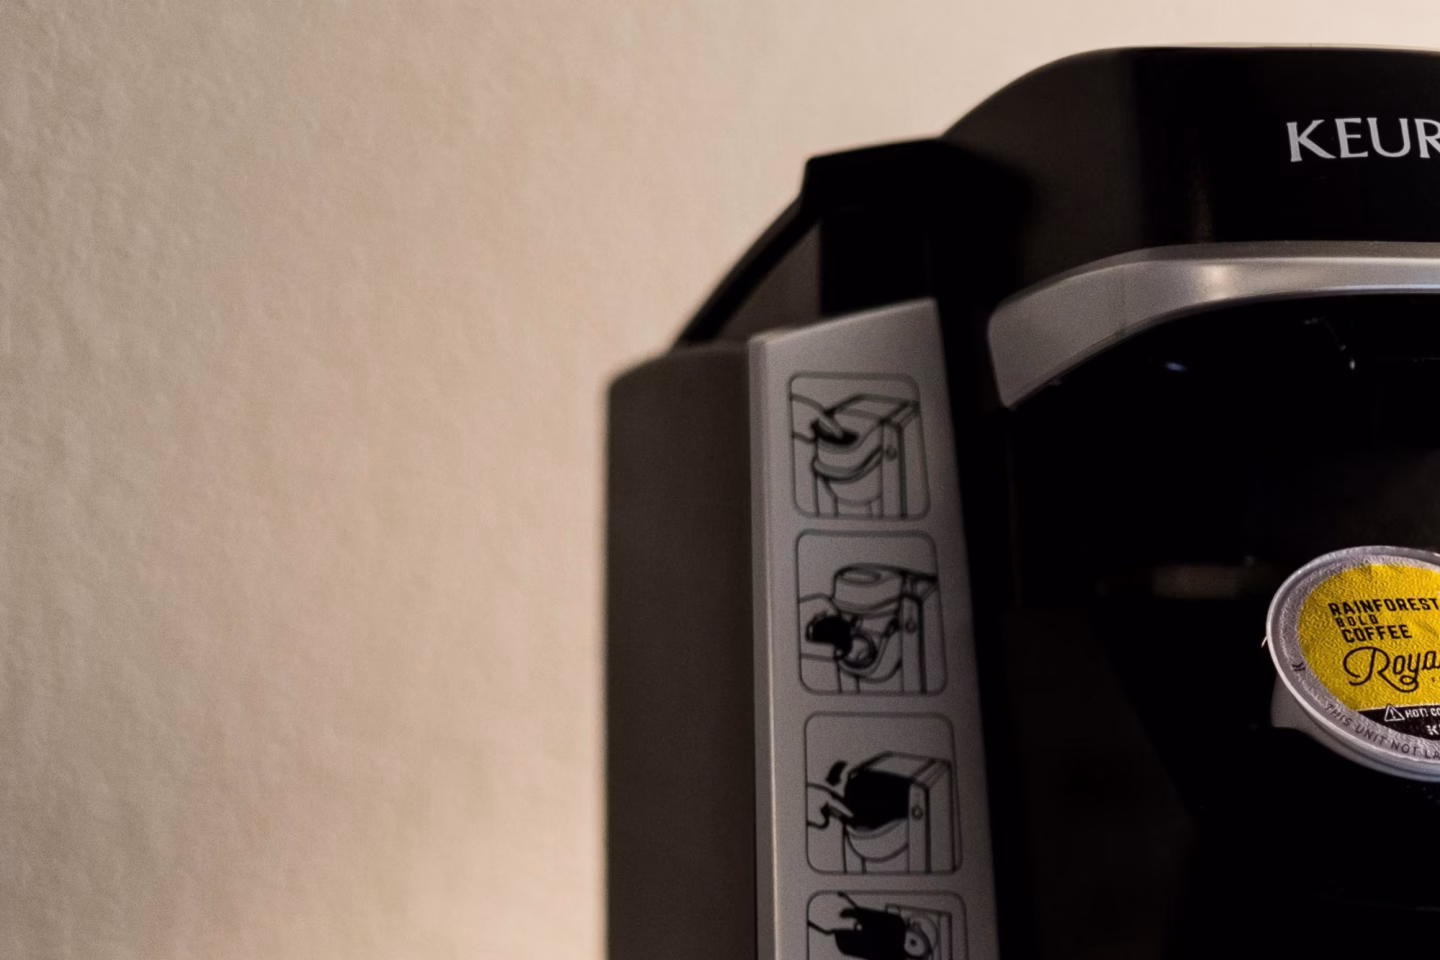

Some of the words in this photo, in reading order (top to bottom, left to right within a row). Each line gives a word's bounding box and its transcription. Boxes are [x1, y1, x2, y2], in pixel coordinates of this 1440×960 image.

[1327, 597, 1440, 616] RAINFOREST
[1335, 614, 1380, 628] BOLD
[1341, 624, 1413, 643] COFFEE
[1325, 703, 1353, 727] THIS
[1355, 724, 1387, 745] UNIT
[1391, 740, 1418, 756] NOT
